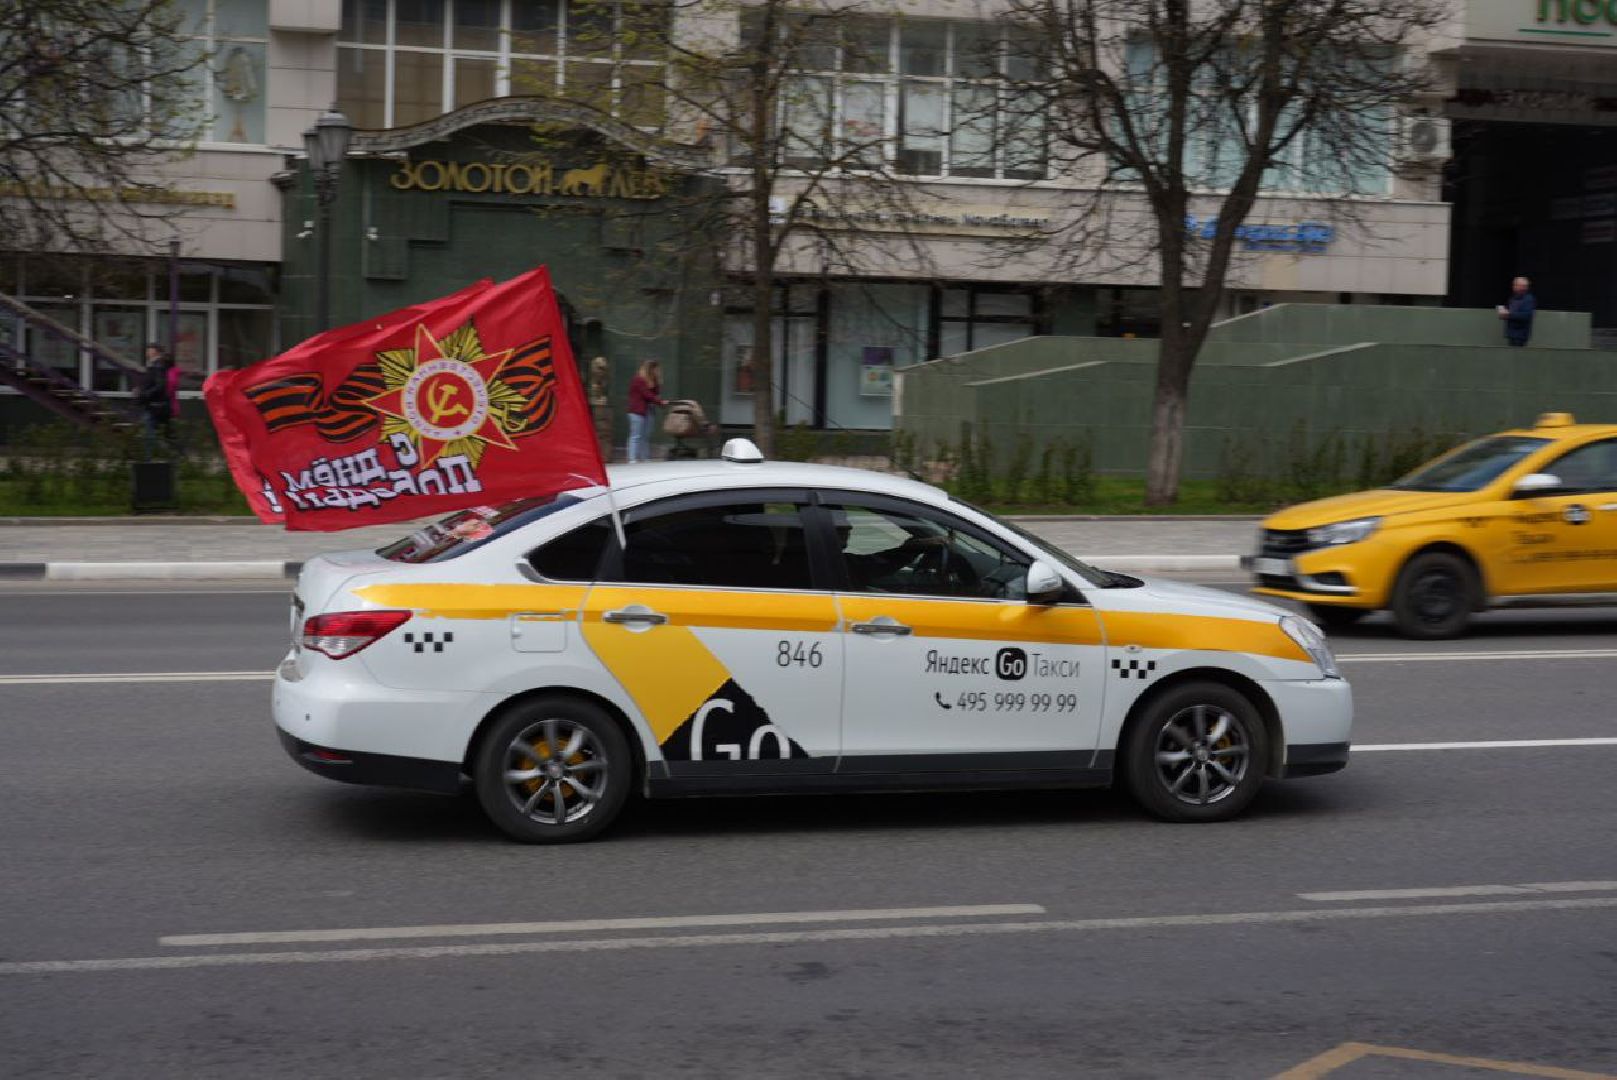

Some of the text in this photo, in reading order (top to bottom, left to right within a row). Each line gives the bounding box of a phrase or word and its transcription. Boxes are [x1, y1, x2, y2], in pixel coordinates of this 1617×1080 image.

[390, 158, 552, 196] ЗОЛОТОЙ
[776, 639, 823, 668] 846
[925, 649, 1080, 678] Яндекс Go Такси
[957, 692, 1077, 713] 495 999 99 99
[690, 698, 791, 761] Go
